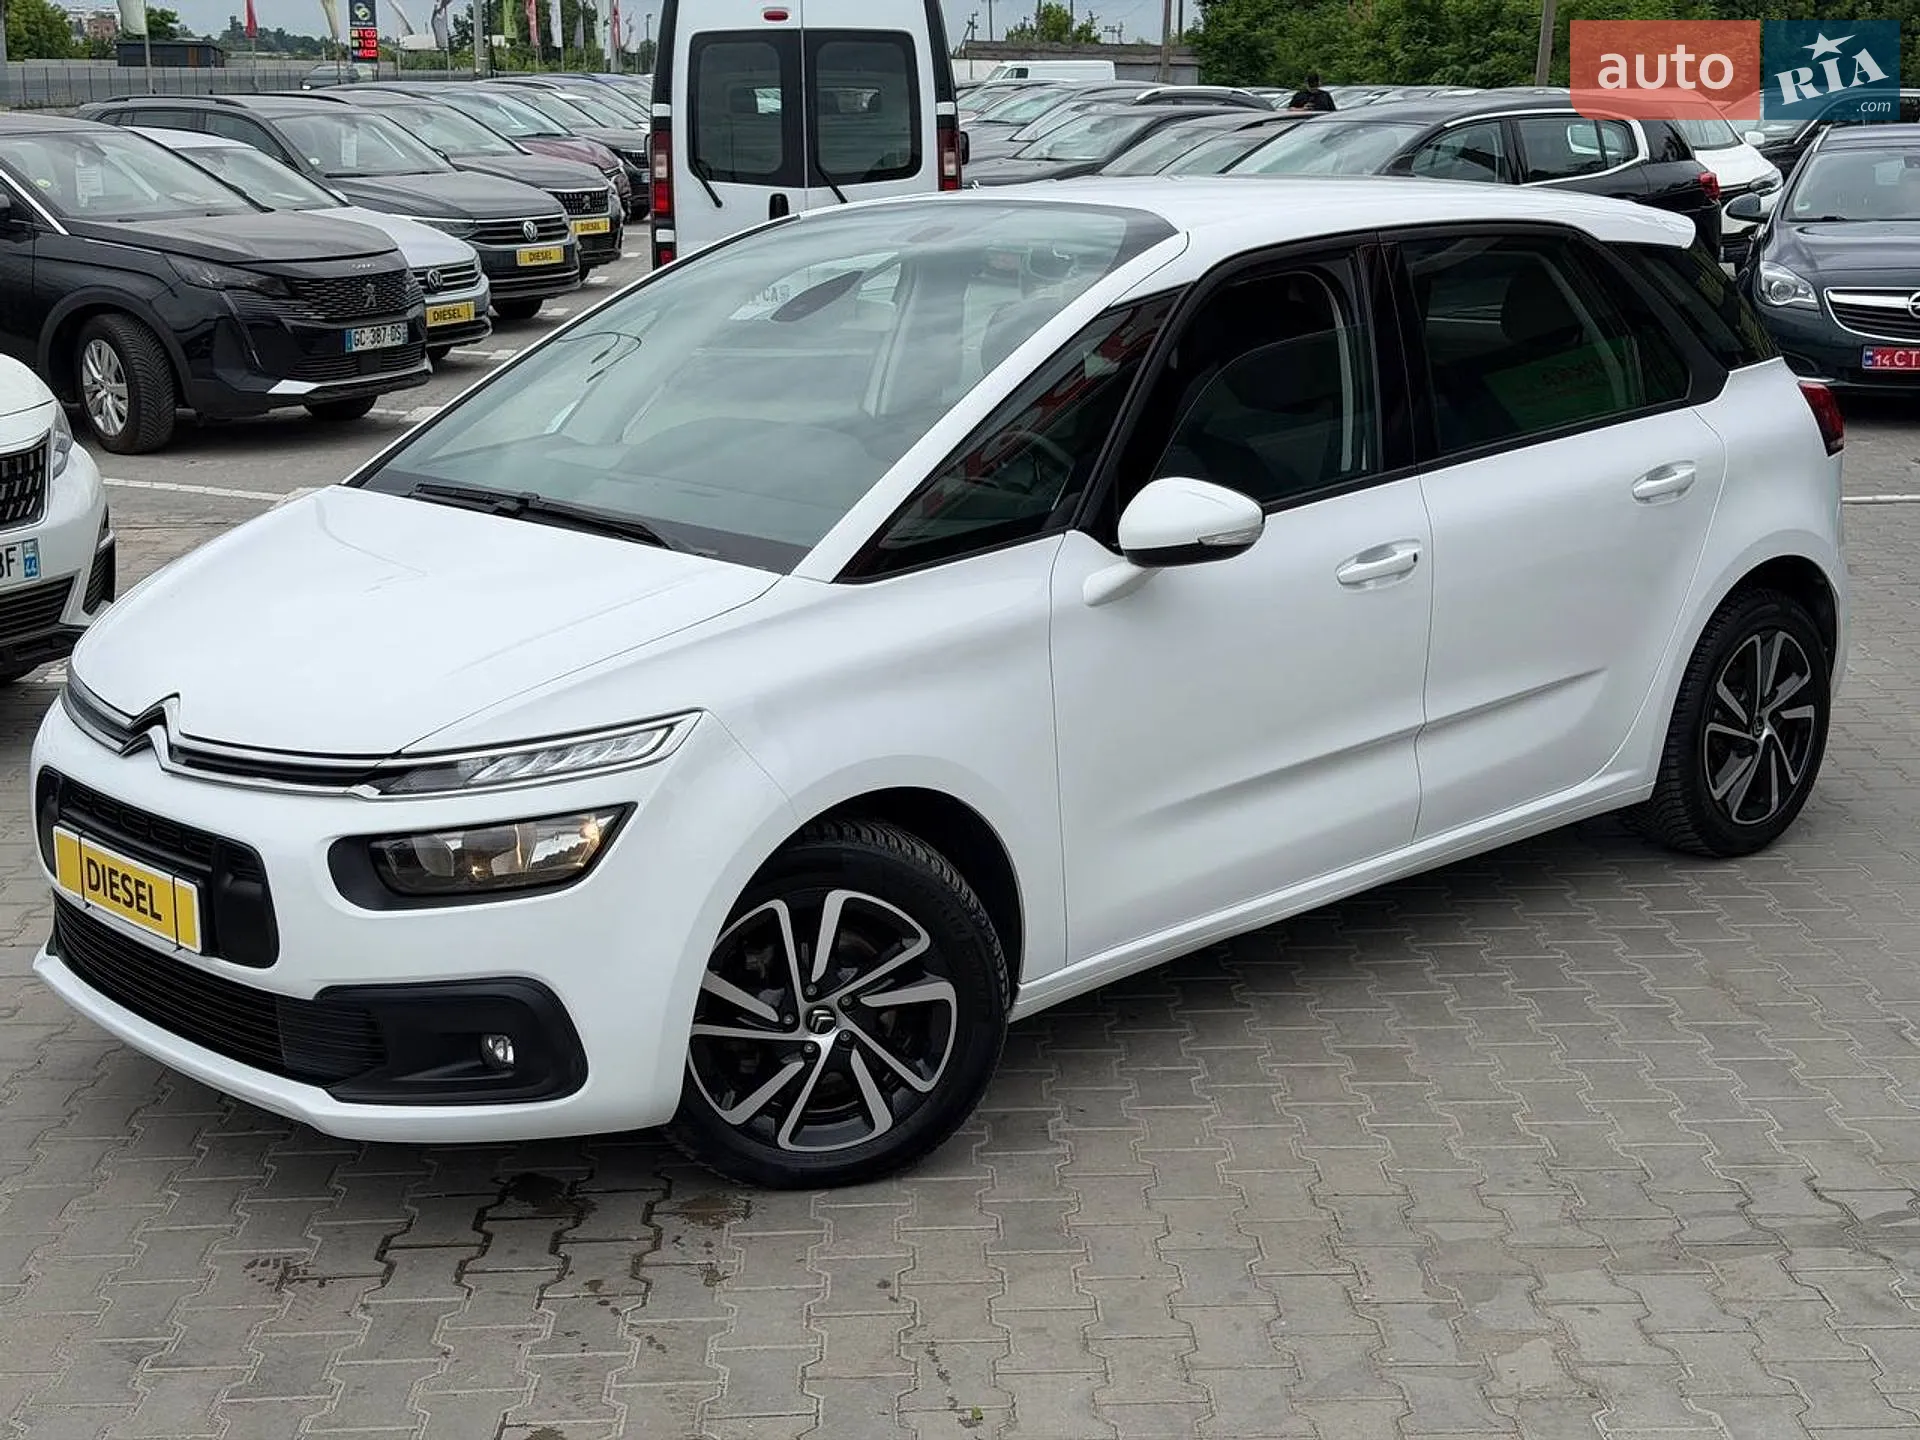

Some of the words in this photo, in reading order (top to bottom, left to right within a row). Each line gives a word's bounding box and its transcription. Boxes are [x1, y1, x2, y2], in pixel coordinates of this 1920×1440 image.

[528, 251, 553, 262] DIESEL
[432, 308, 462, 321] DIESEL
[86, 857, 162, 922] DIESEL
